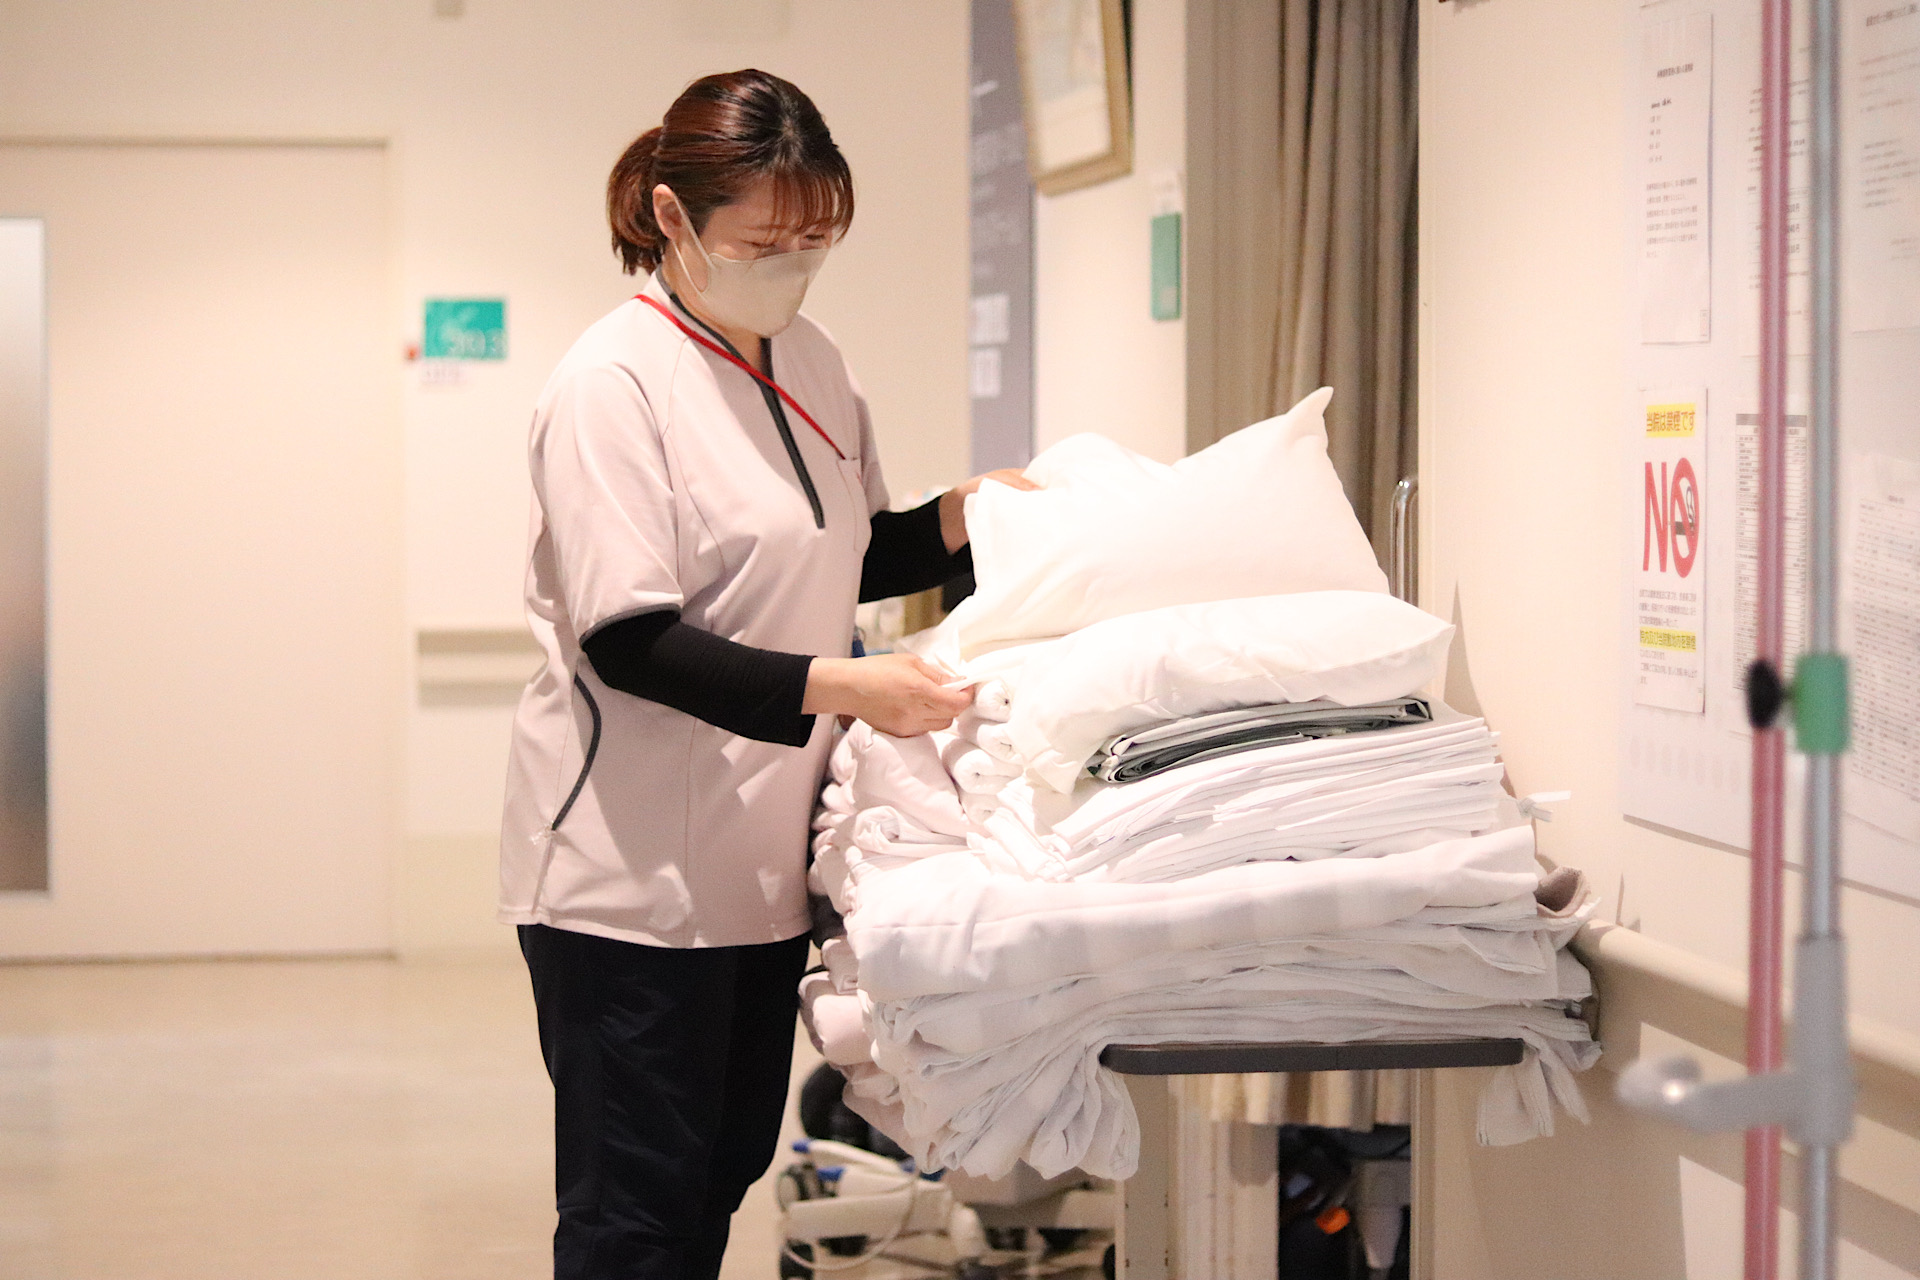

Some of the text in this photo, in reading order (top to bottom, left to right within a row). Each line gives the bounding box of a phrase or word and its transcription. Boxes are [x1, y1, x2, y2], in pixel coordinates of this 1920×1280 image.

[1646, 411, 1695, 432] 当院は禁煙です
[1643, 458, 1700, 578] NO
